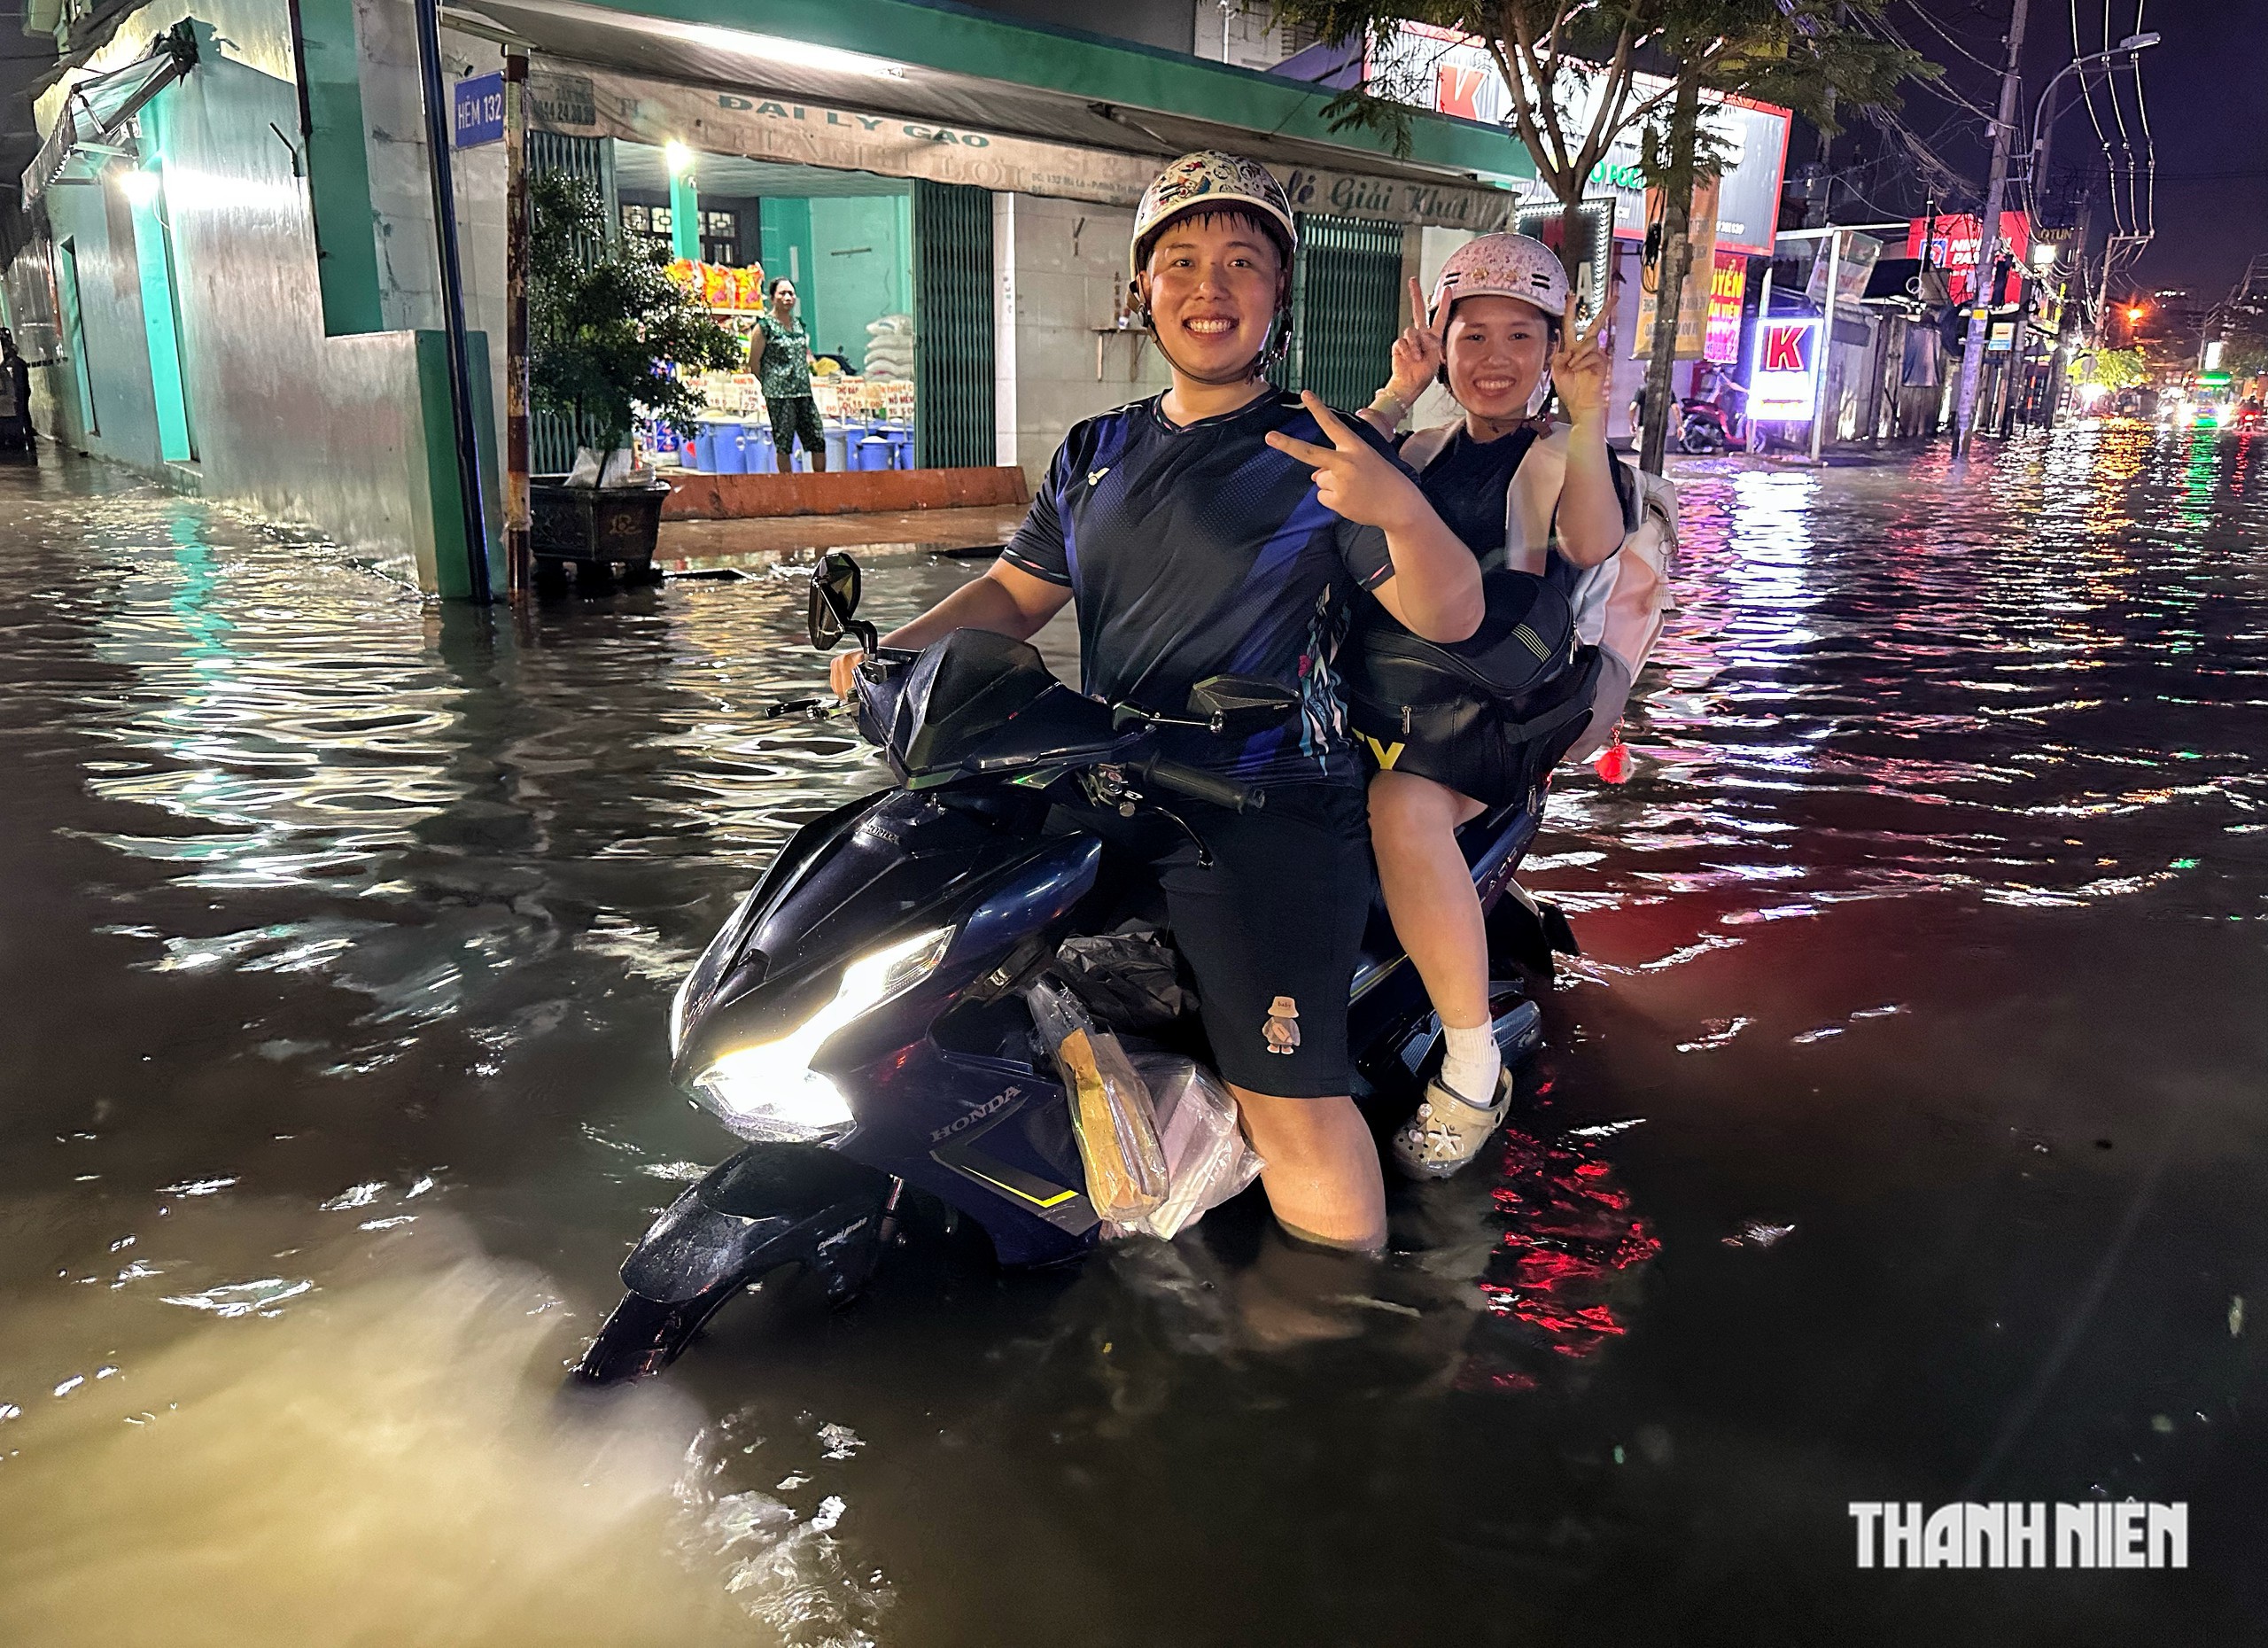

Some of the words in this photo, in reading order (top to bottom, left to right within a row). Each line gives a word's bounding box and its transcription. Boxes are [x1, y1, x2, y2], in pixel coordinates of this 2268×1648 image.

[457, 95, 481, 130] HẺM
[484, 93, 502, 123] 132
[1767, 325, 1805, 371] K
[930, 1085, 1021, 1142] HONDA
